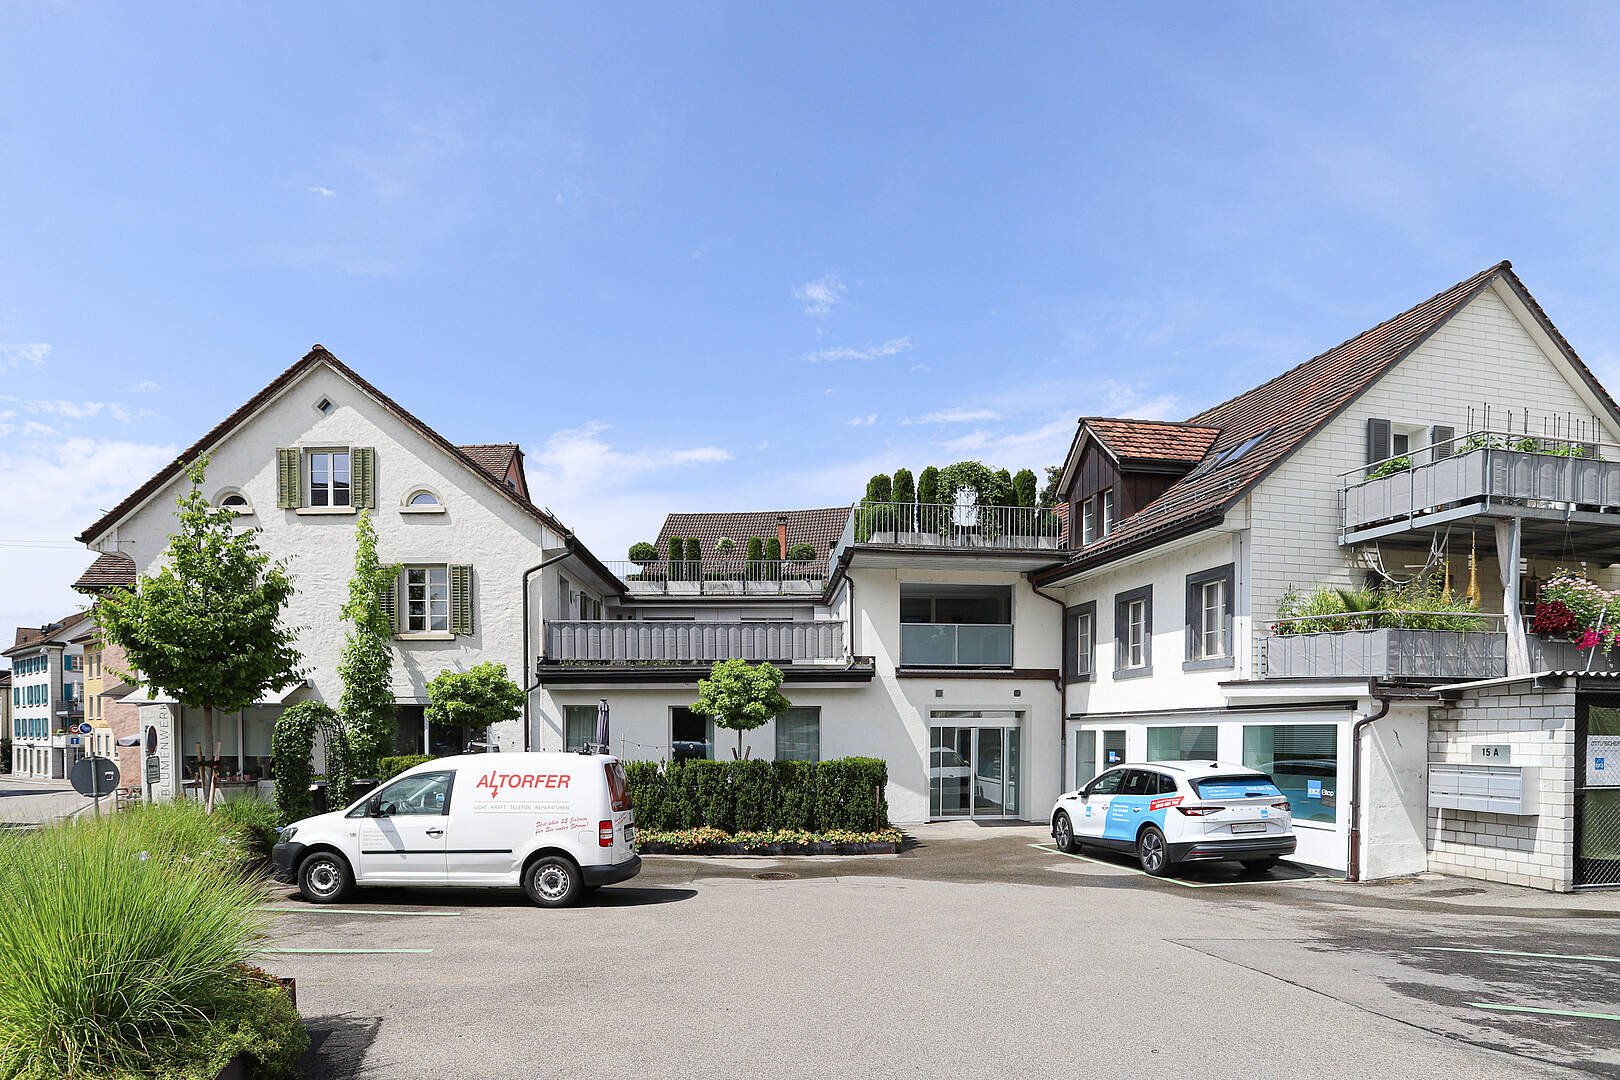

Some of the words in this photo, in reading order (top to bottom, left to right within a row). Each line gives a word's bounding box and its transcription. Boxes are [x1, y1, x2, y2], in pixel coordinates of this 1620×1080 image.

[159, 704, 171, 797] BLUMENWERK
[1481, 748, 1491, 757] 15
[1493, 748, 1499, 757] A
[476, 771, 571, 798] ALTORFER
